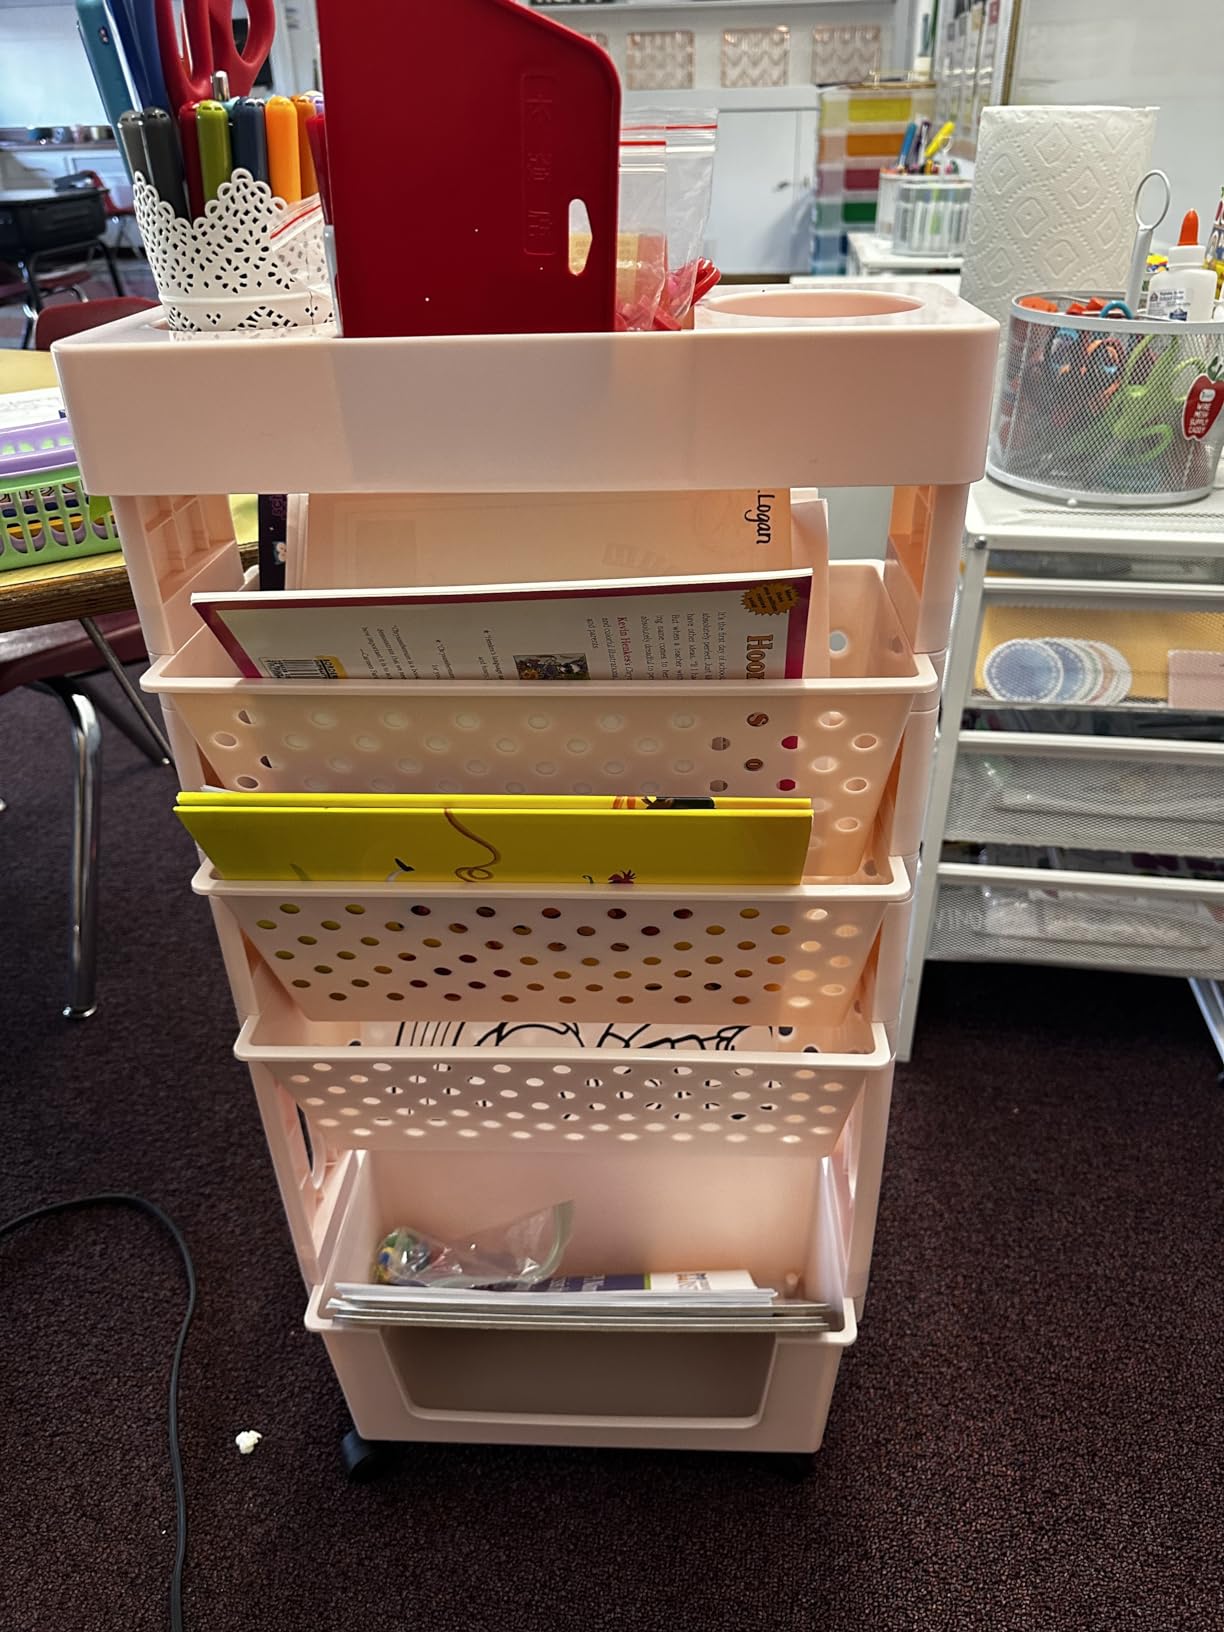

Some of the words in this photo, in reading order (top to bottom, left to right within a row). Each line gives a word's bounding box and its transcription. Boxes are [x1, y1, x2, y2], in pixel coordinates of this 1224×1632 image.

[586, 618, 597, 629] and
[601, 617, 612, 628] and
[671, 614, 681, 624] But
[687, 613, 697, 627] have
[718, 621, 727, 631] the
[617, 616, 630, 637] Kevin
[657, 625, 665, 641] name
[672, 626, 681, 641] when
[701, 613, 712, 641] absolutely
[687, 628, 697, 643] other
[718, 632, 727, 643] first
[659, 642, 668, 660] comes
